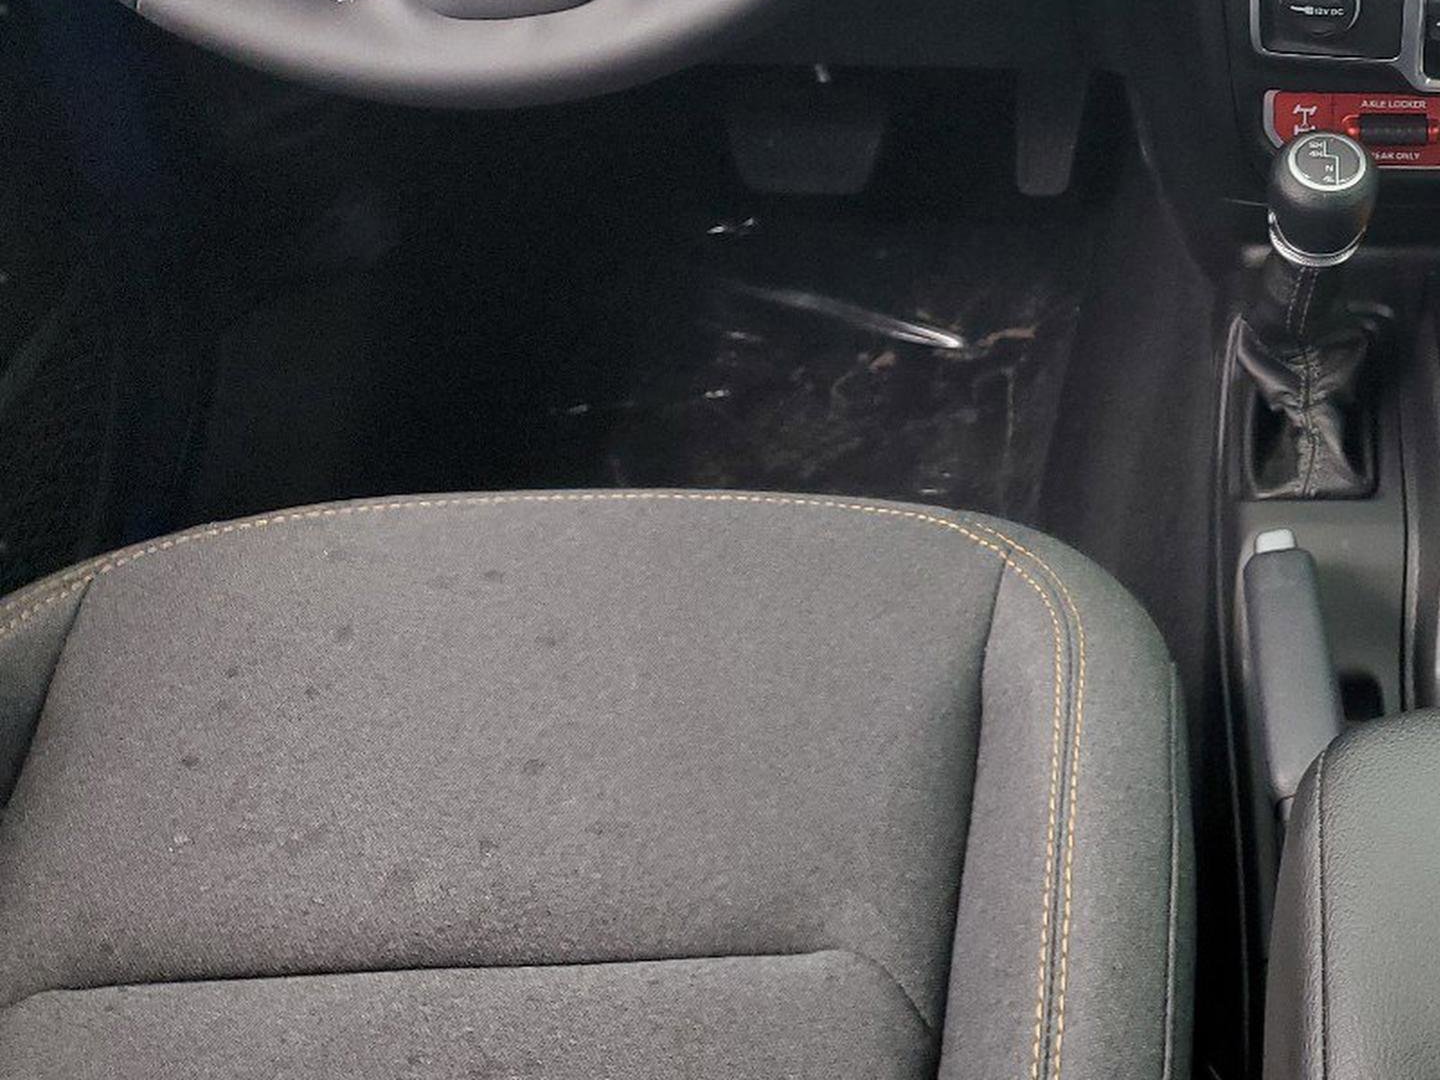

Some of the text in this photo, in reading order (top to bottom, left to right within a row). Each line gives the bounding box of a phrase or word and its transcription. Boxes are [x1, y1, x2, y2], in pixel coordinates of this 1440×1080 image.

[1314, 7, 1329, 15] 12V
[1361, 100, 1427, 109] AXLE LOCKER
[1395, 151, 1420, 159] ONLY
